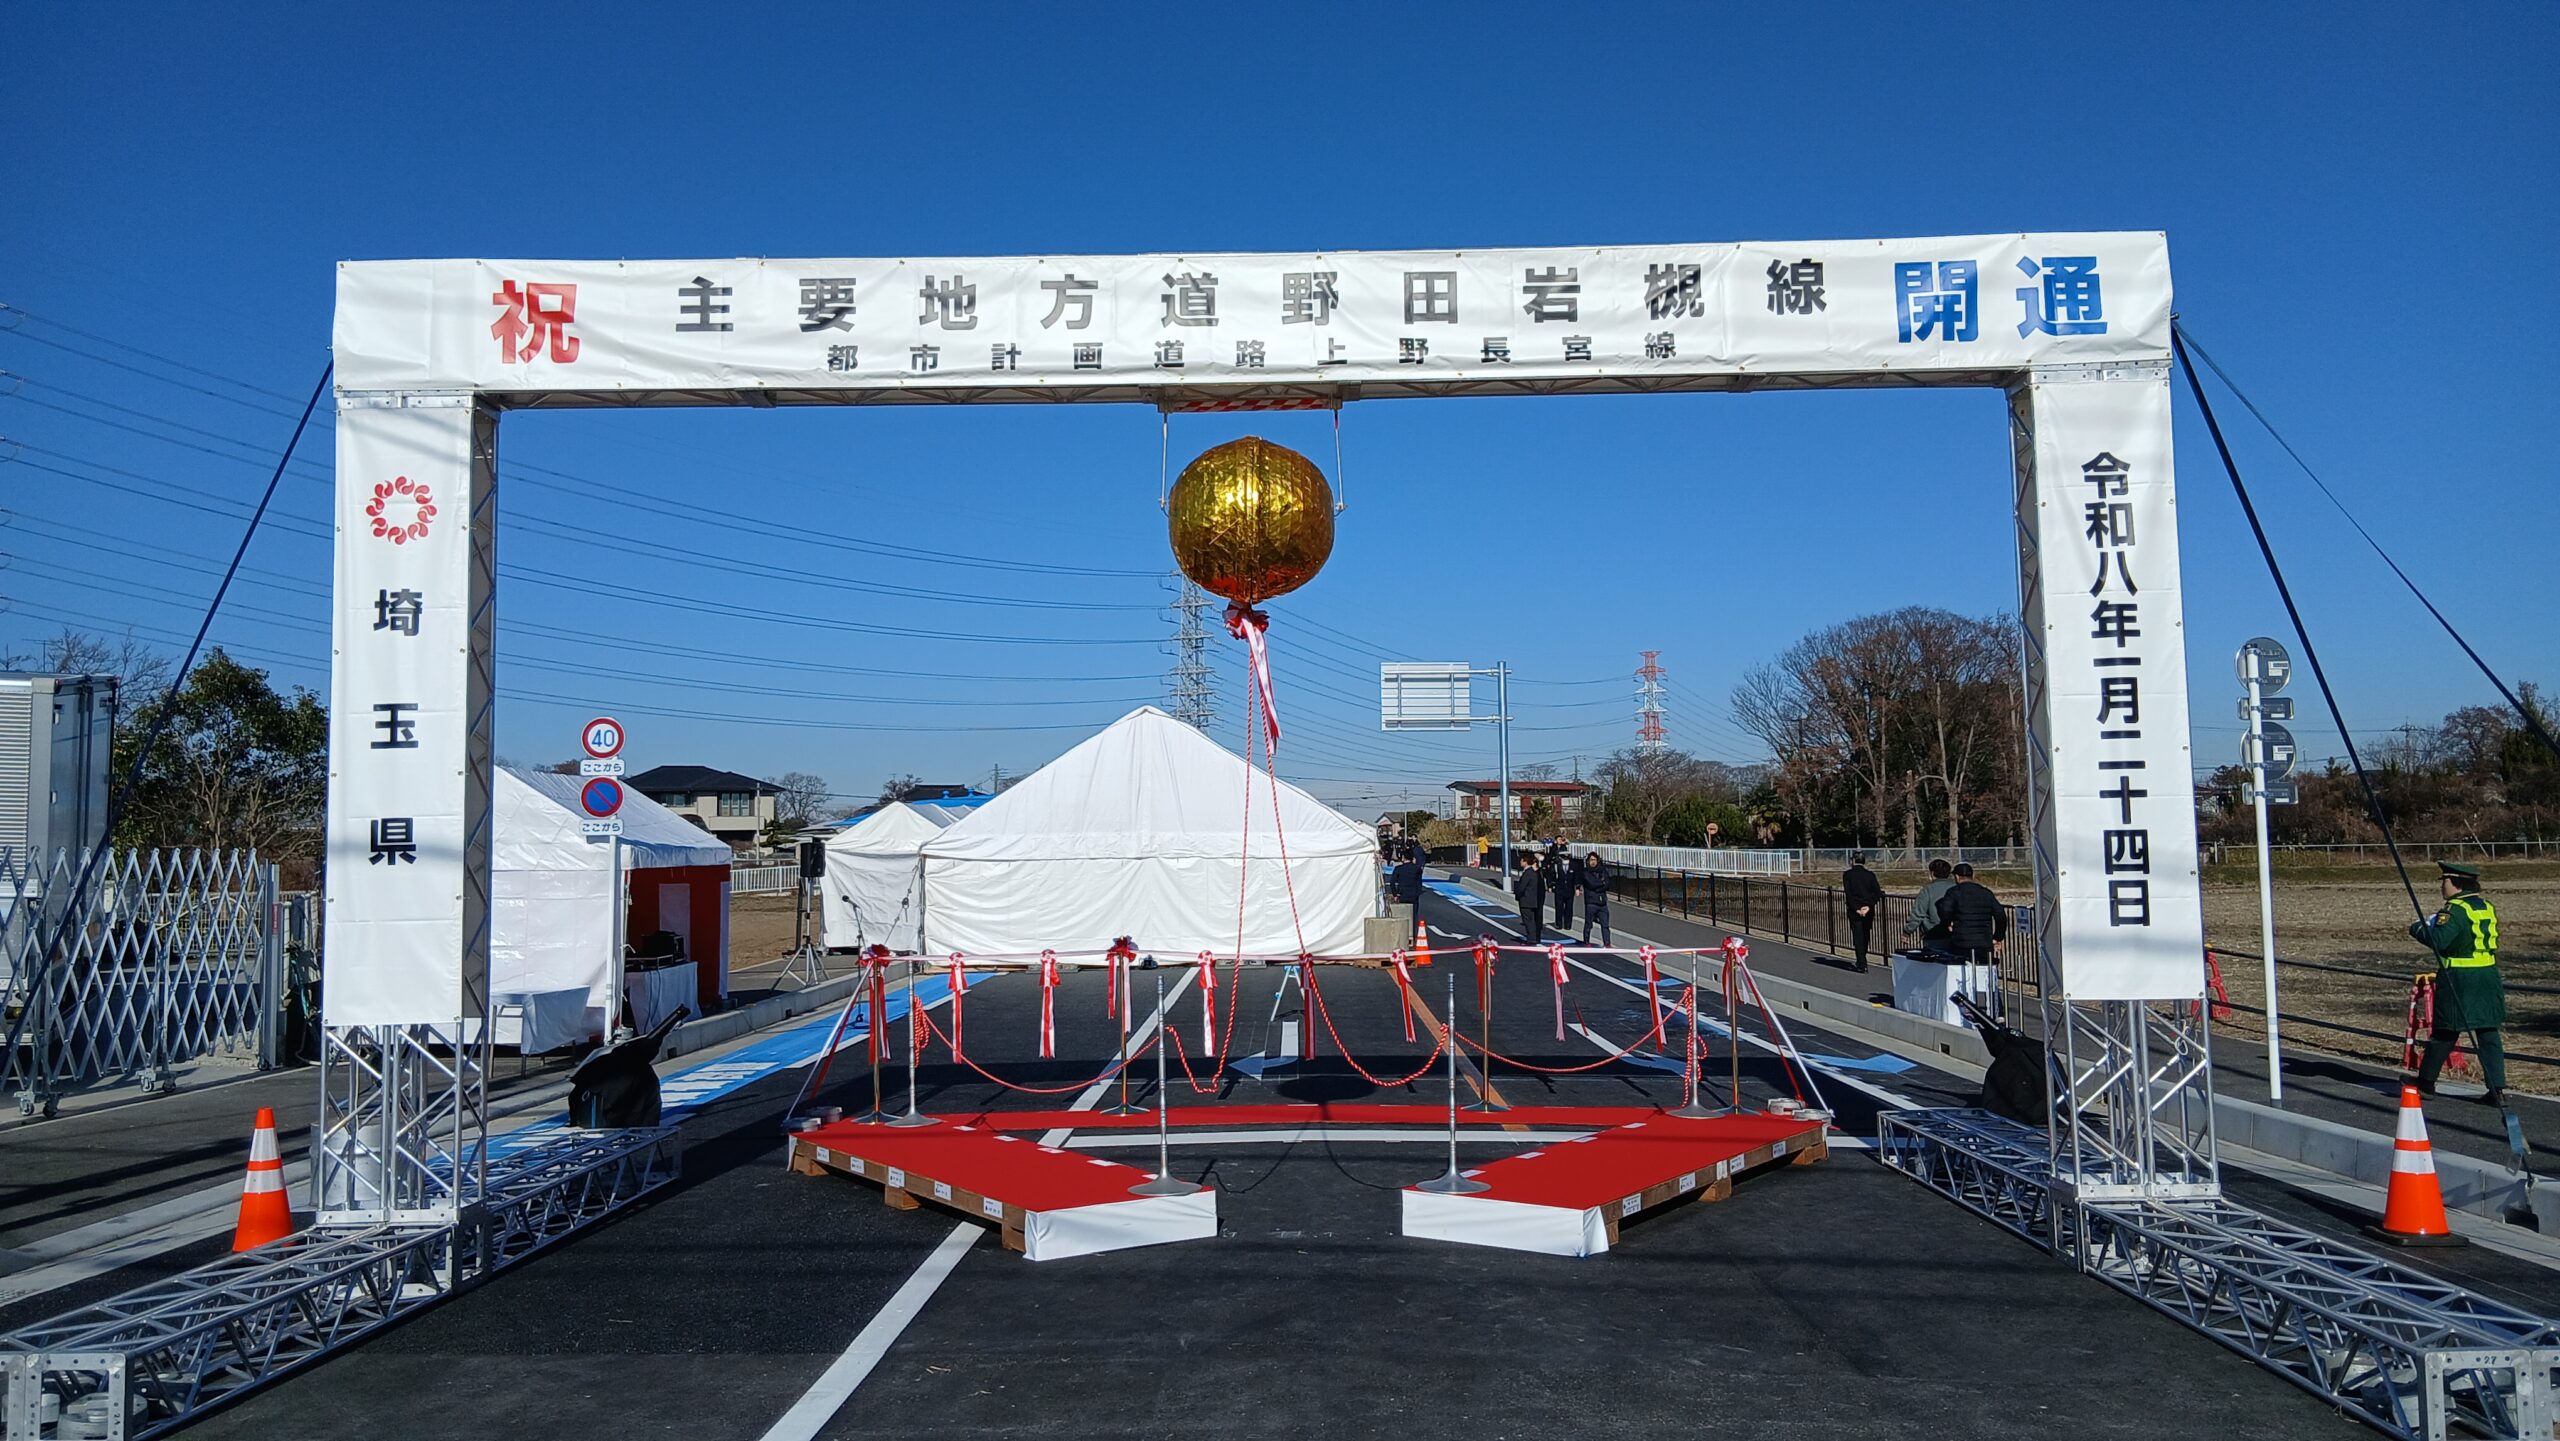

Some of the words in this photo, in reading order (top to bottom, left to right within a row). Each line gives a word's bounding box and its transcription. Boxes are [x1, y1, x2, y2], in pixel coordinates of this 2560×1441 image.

[492, 279, 580, 364] 祝
[675, 258, 1827, 333] 主要地方道野田岩槻線
[1893, 255, 2108, 344] 開通
[827, 331, 1677, 373] 都市計画道路上野長宮線
[2081, 451, 2151, 927] 令和八年一月二十四日
[368, 588, 423, 866] 埼玉県
[591, 729, 615, 747] 40
[583, 763, 622, 772] ここから
[582, 823, 621, 832] ここから
